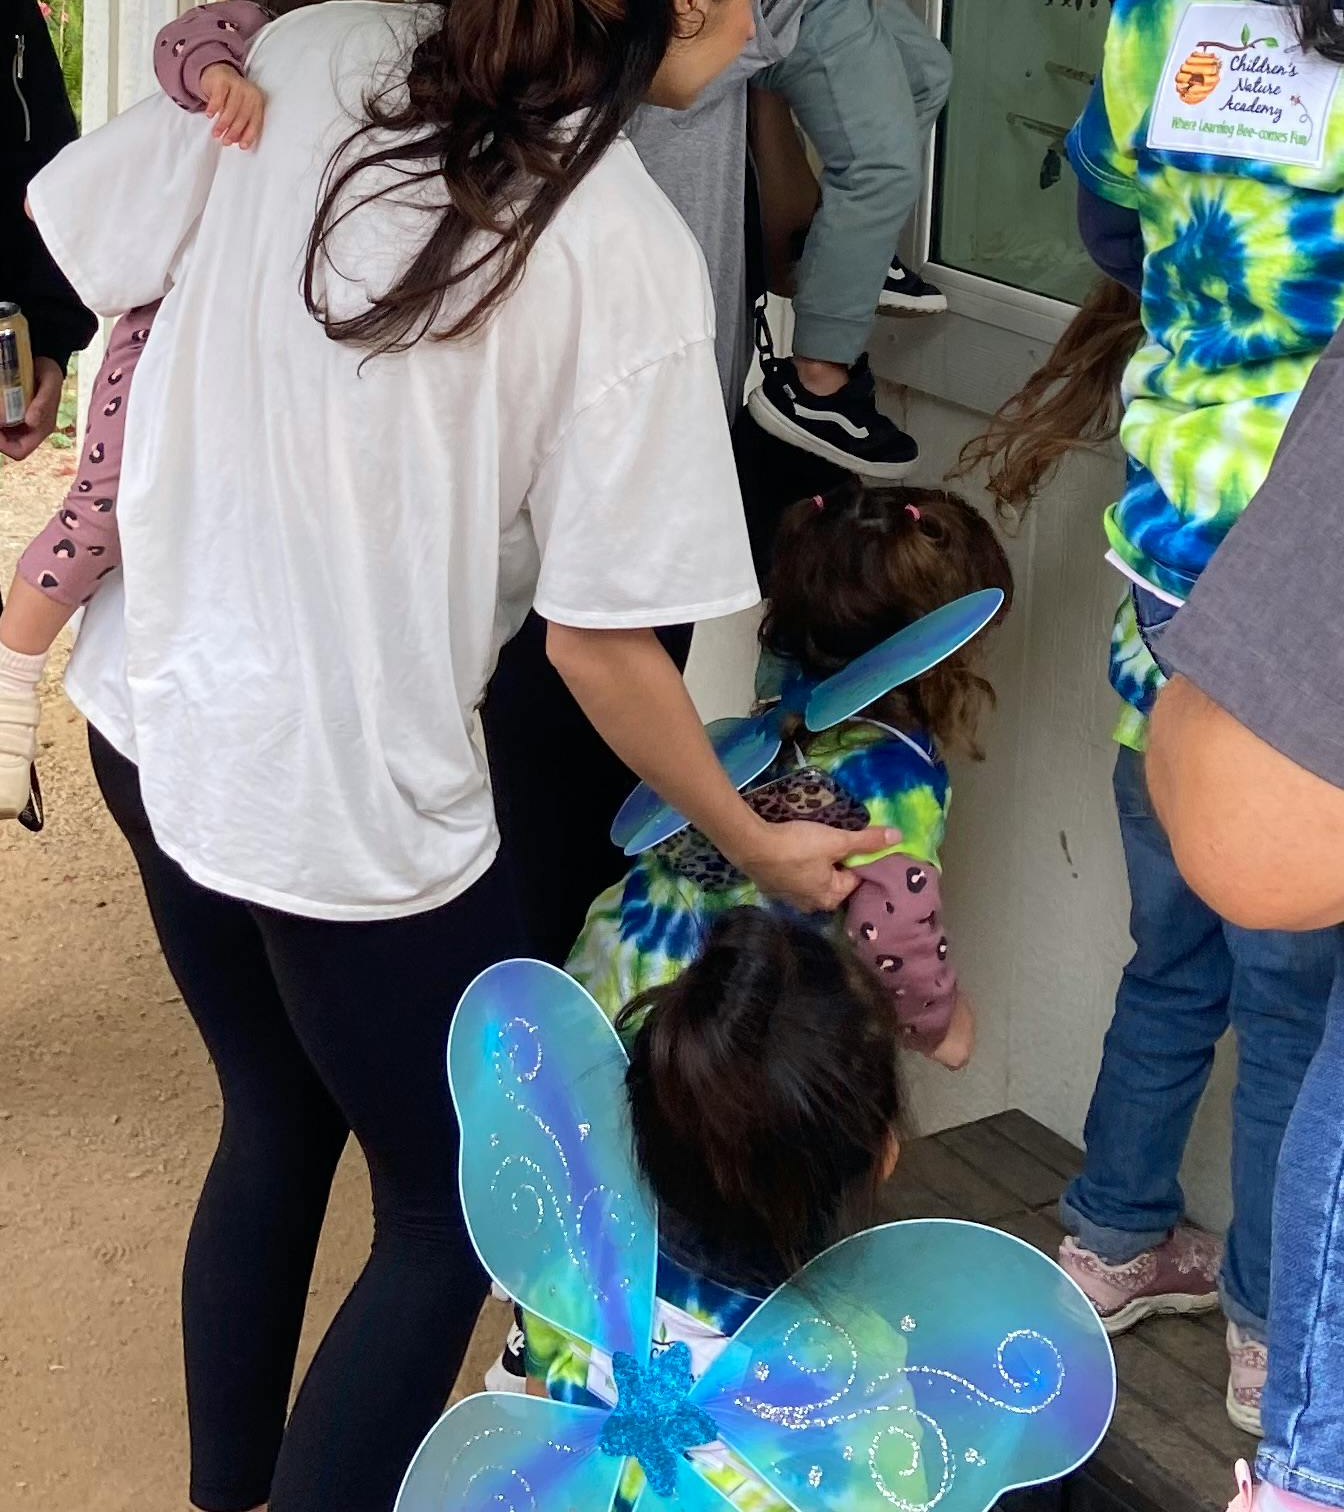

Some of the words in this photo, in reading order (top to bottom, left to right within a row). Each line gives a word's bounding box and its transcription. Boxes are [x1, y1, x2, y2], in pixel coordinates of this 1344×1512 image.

[1230, 54, 1299, 77] Children's
[1232, 77, 1282, 95] Nature
[1219, 95, 1282, 124] Academy
[1172, 116, 1196, 129] Where
[1199, 120, 1235, 138] Learning
[1237, 124, 1289, 141] Bee-comes
[1290, 131, 1307, 146] Fun
